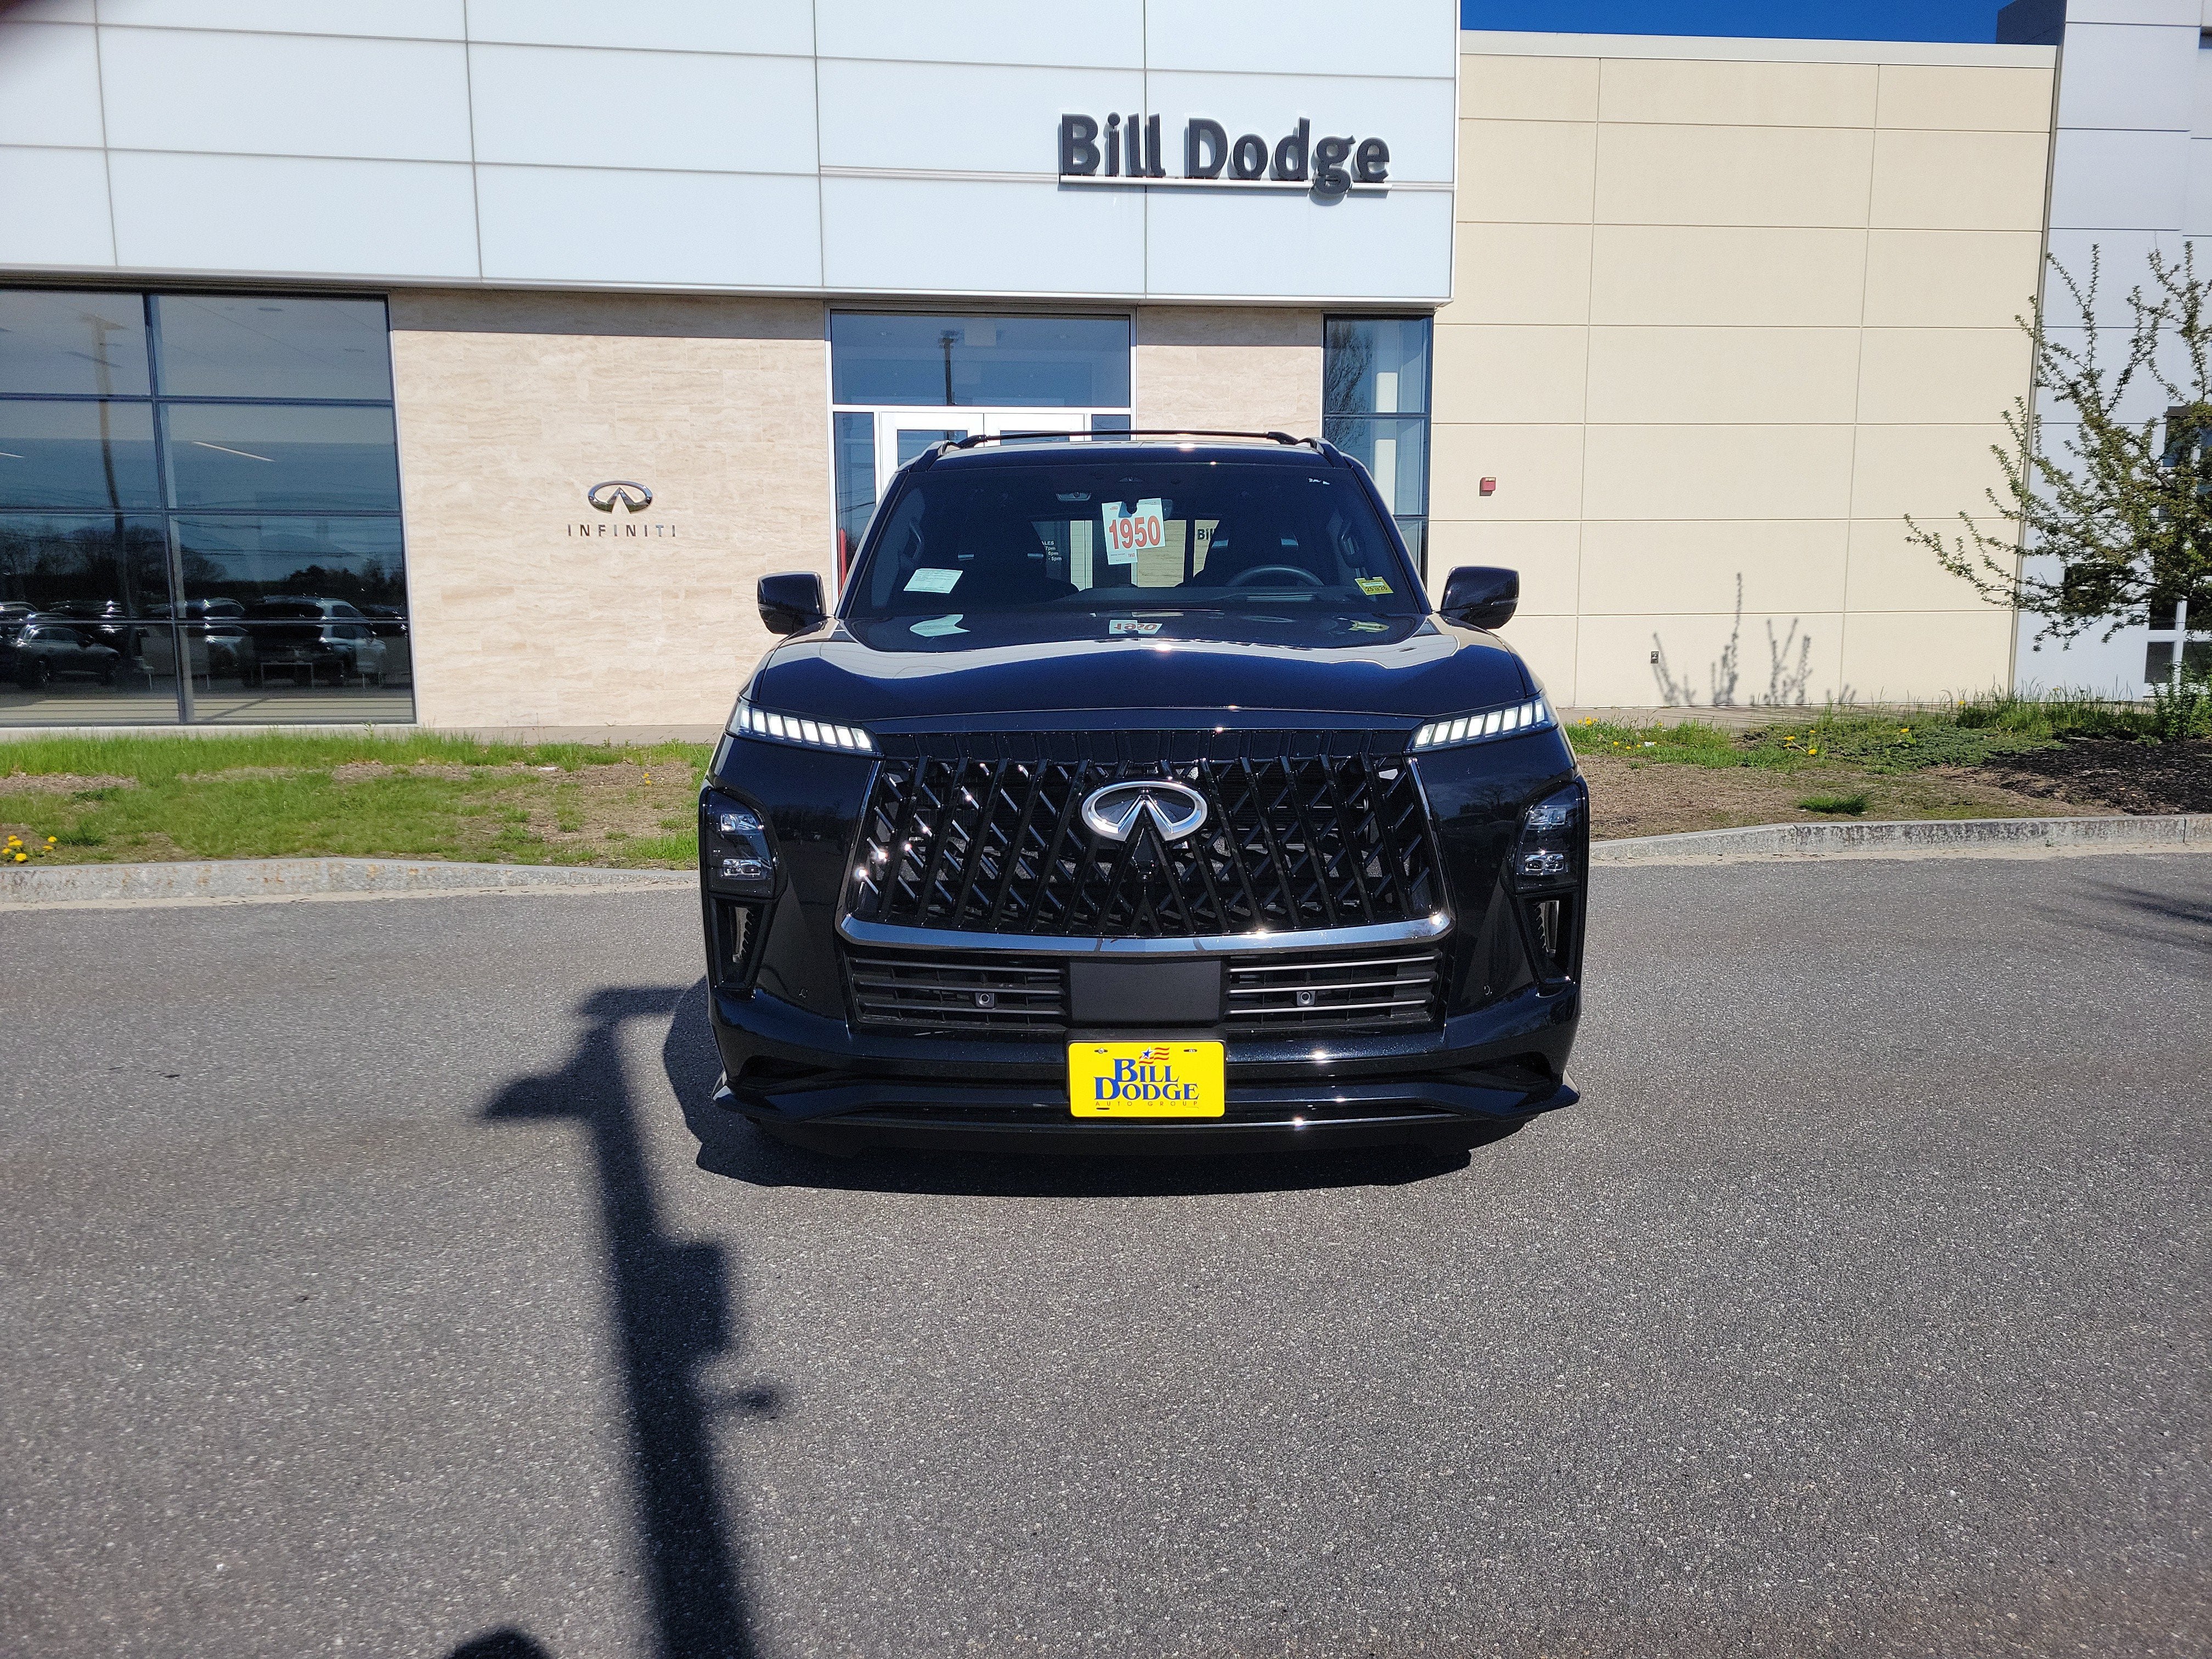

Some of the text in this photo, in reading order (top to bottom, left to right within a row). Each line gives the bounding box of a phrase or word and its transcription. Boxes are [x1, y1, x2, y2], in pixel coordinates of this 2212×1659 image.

[1060, 111, 1391, 195] Bill Dodge
[567, 523, 676, 537] INFINITI
[1109, 515, 1161, 550] 1950
[1113, 1058, 1180, 1083] BILL
[1093, 1076, 1200, 1101] DODGE
